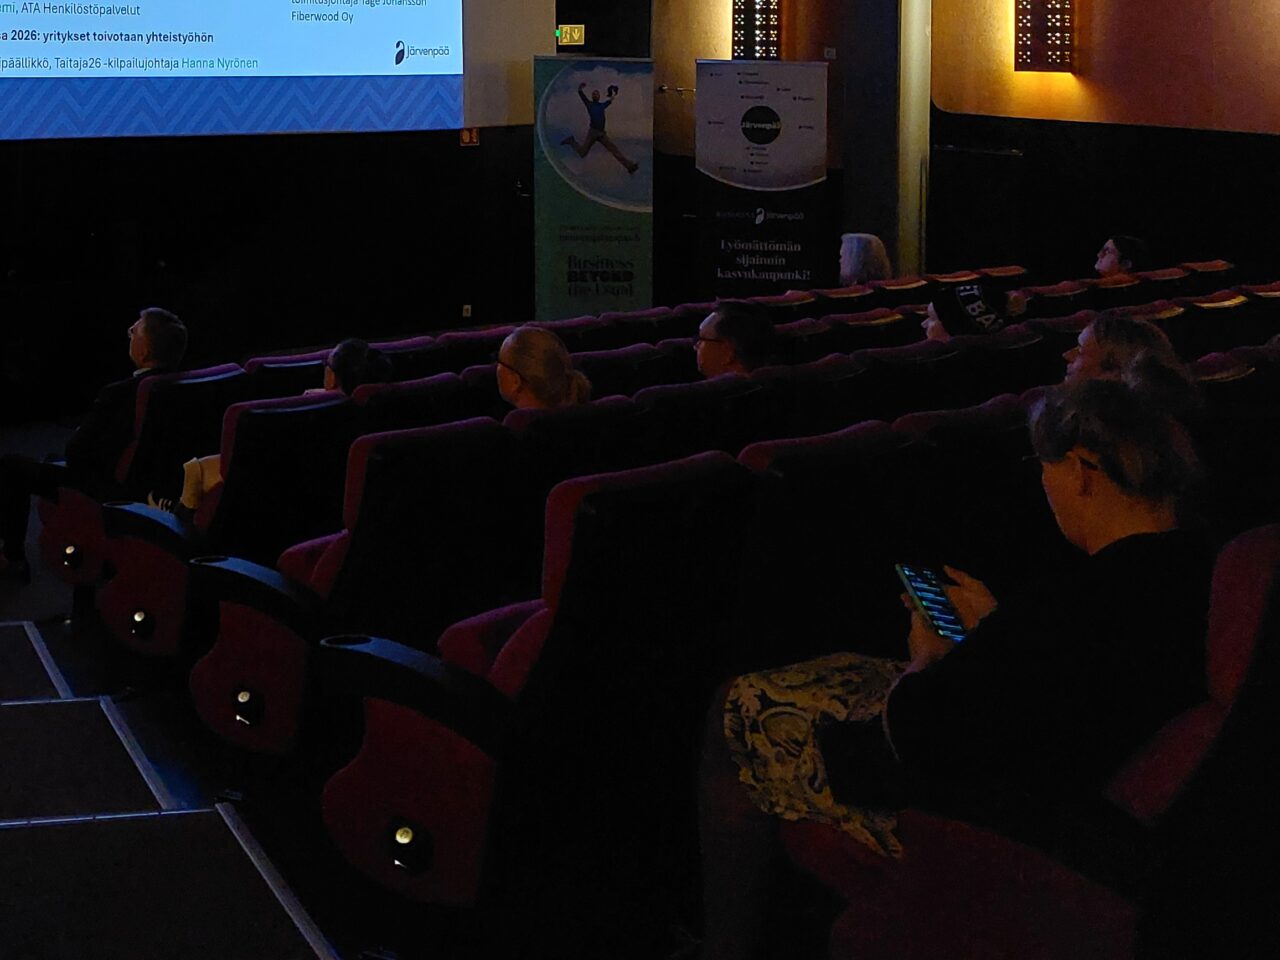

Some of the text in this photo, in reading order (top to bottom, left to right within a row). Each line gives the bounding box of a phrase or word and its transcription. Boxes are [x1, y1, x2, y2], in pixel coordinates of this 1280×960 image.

[21, 2, 41, 14] ATA
[43, 2, 140, 18] Henkilöstöpalvelut
[291, 10, 354, 24] Fiberwood Oy
[10, 29, 40, 41] 2026:
[42, 30, 90, 44] yritykset
[92, 30, 144, 42] toivotaan
[145, 31, 214, 45] yhteistyöhön
[405, 45, 450, 58] Järvenpää
[54, 57, 102, 71] Taitaja26
[104, 57, 179, 71] -kilpailujohtaja
[182, 58, 214, 68] Hanna
[217, 57, 258, 71] Nyrönen
